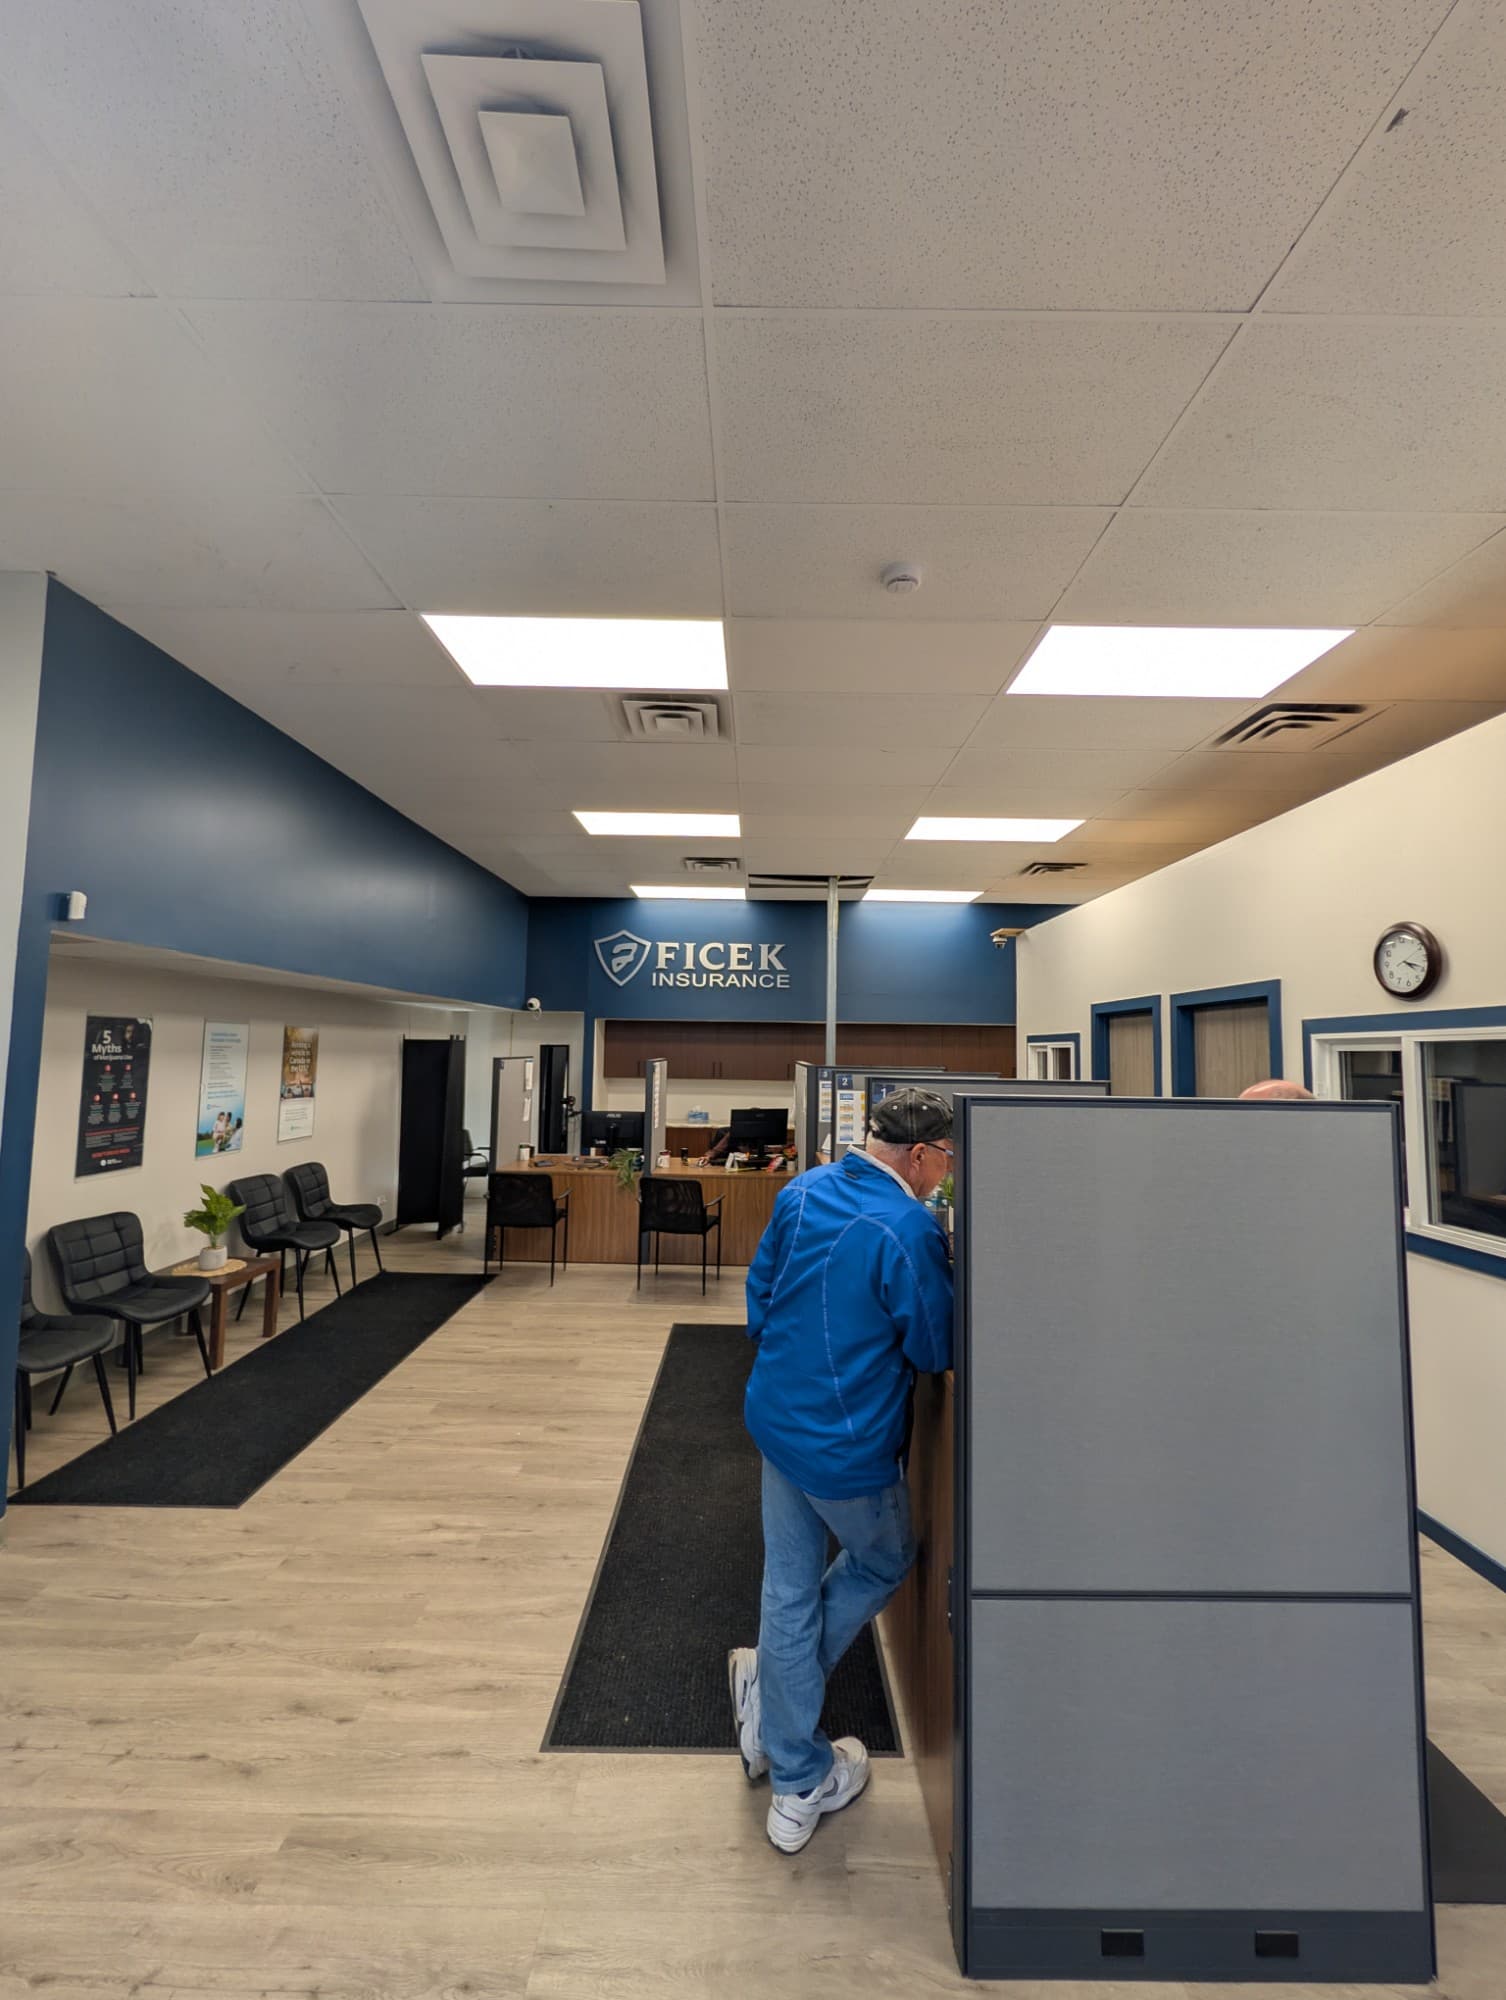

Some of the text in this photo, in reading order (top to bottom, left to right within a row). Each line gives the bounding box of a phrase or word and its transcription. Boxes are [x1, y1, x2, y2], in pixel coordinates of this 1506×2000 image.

[655, 941, 787, 971] FICEK
[651, 972, 791, 989] INSURANCE
[103, 1030, 112, 1044] 5
[92, 1043, 122, 1055] Myths
[841, 1077, 848, 1086] 2
[880, 1088, 887, 1099] 1
